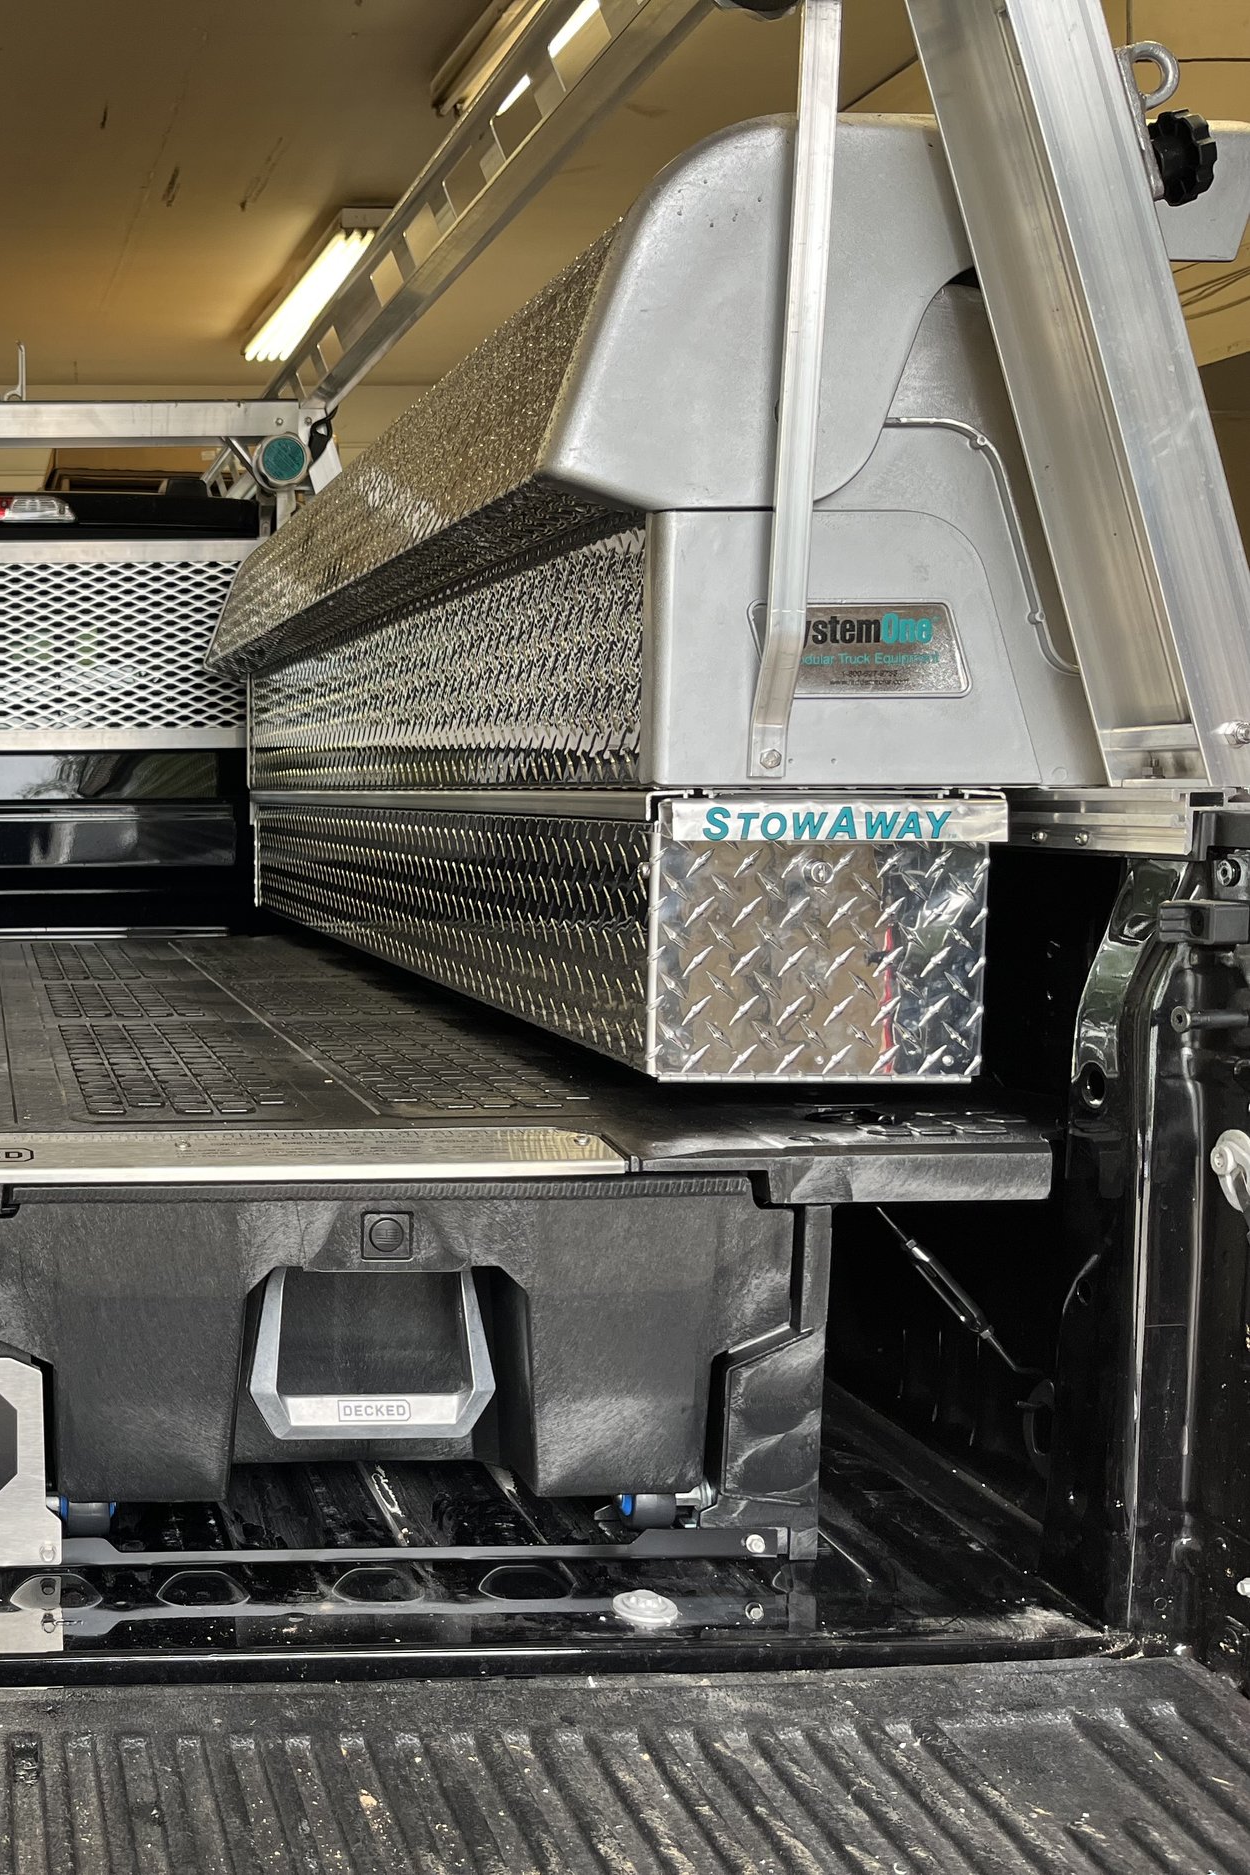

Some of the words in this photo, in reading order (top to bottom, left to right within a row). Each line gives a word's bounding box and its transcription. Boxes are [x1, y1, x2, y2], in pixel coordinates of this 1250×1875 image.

[802, 612, 933, 649] stemOne
[838, 653, 870, 664] Truck
[343, 1404, 406, 1417] DECKED
